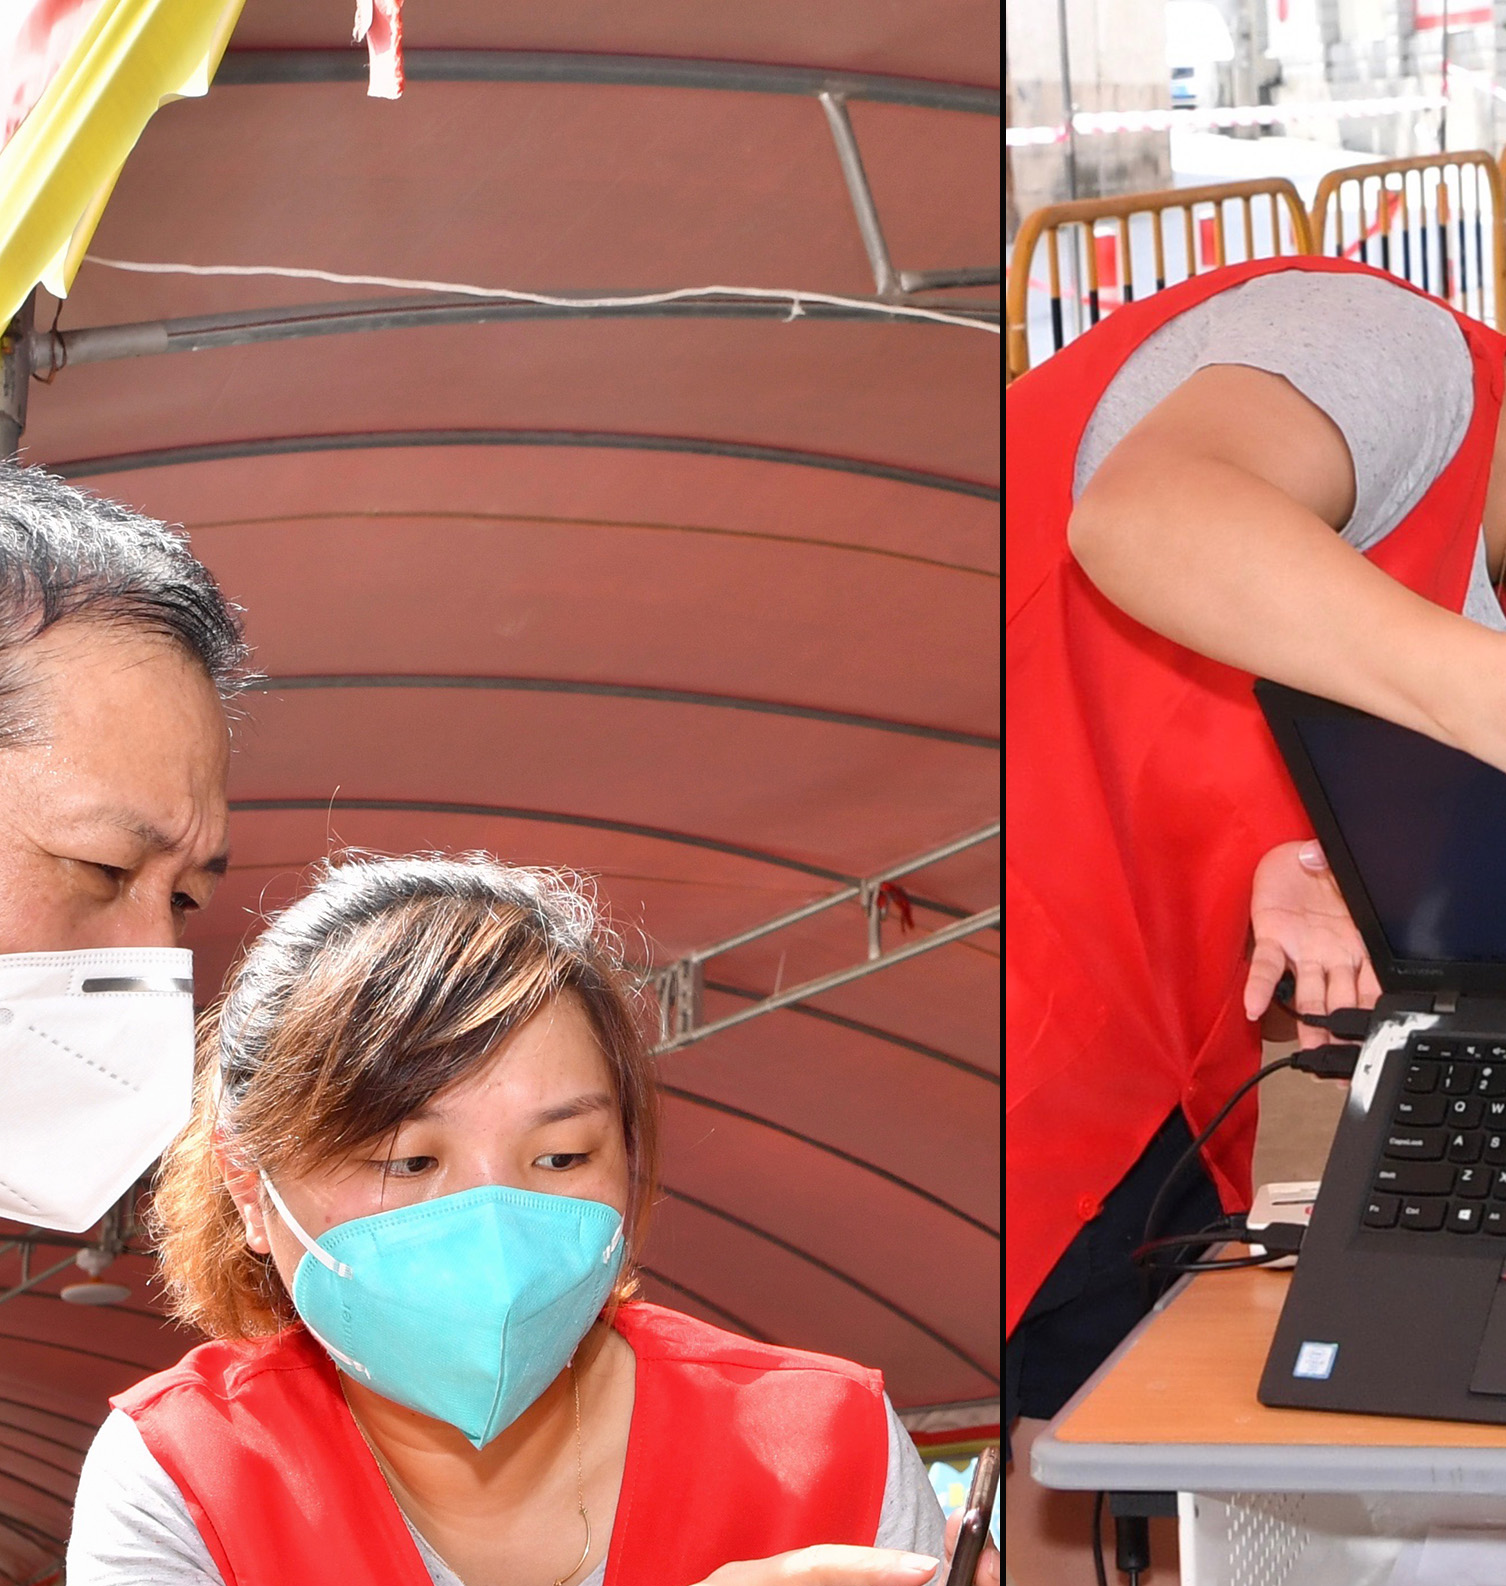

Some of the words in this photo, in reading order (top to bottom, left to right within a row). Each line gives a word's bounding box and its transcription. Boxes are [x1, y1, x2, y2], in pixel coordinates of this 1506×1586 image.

[1479, 1079, 1489, 1090] 2
[1454, 1100, 1466, 1113] Q
[1491, 1103, 1505, 1114] W
[1453, 1135, 1464, 1146] A
[1490, 1136, 1501, 1148] S
[1461, 1169, 1473, 1181] Z
